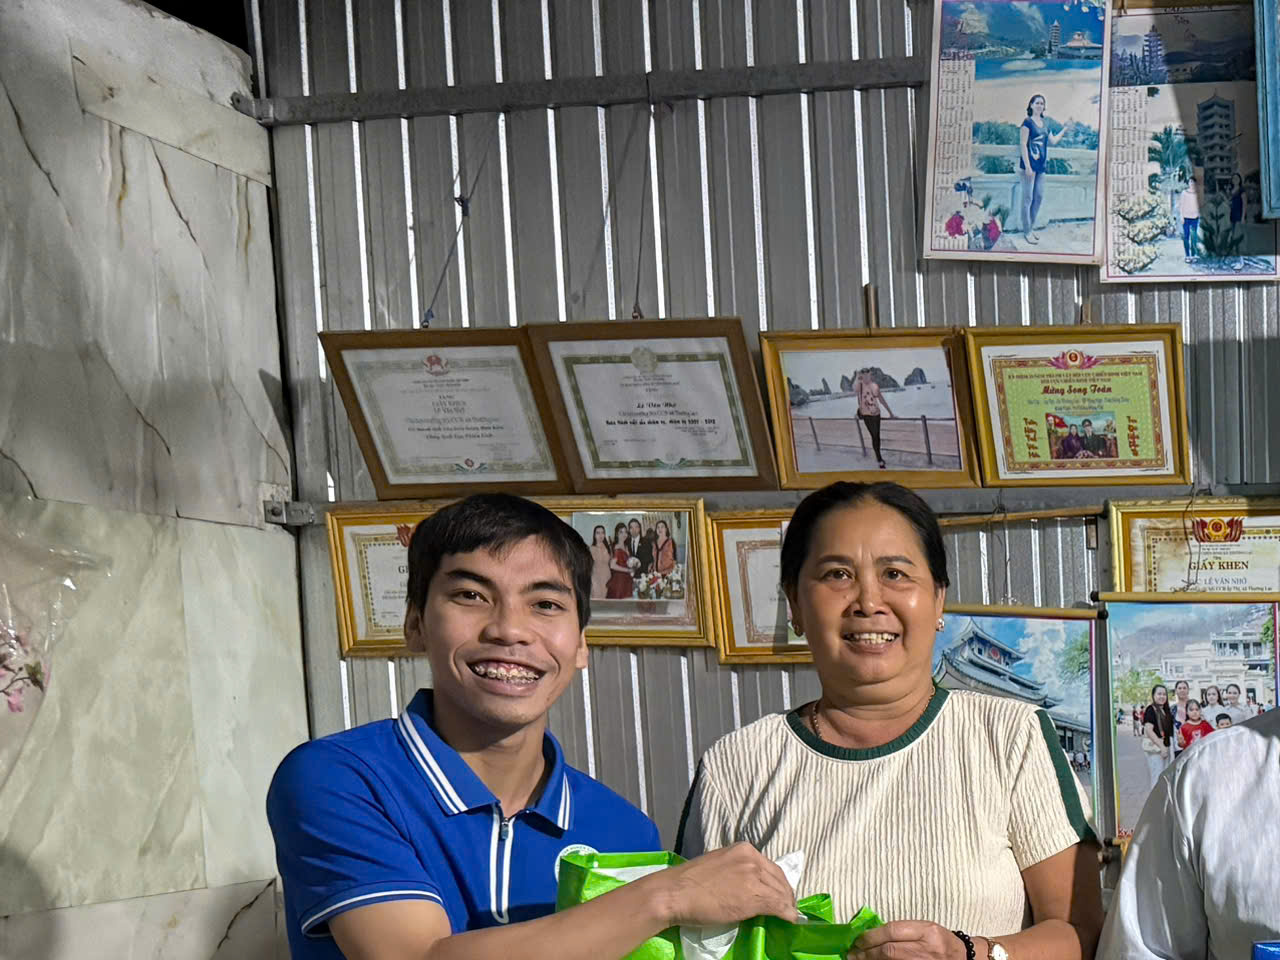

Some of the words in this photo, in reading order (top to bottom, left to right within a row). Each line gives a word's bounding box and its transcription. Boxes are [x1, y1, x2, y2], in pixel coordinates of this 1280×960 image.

[1041, 384, 1065, 396] Mừng
[1188, 558, 1216, 570] GIẤY
[1218, 560, 1249, 570] KHEN
[1214, 576, 1230, 585] VĂN
